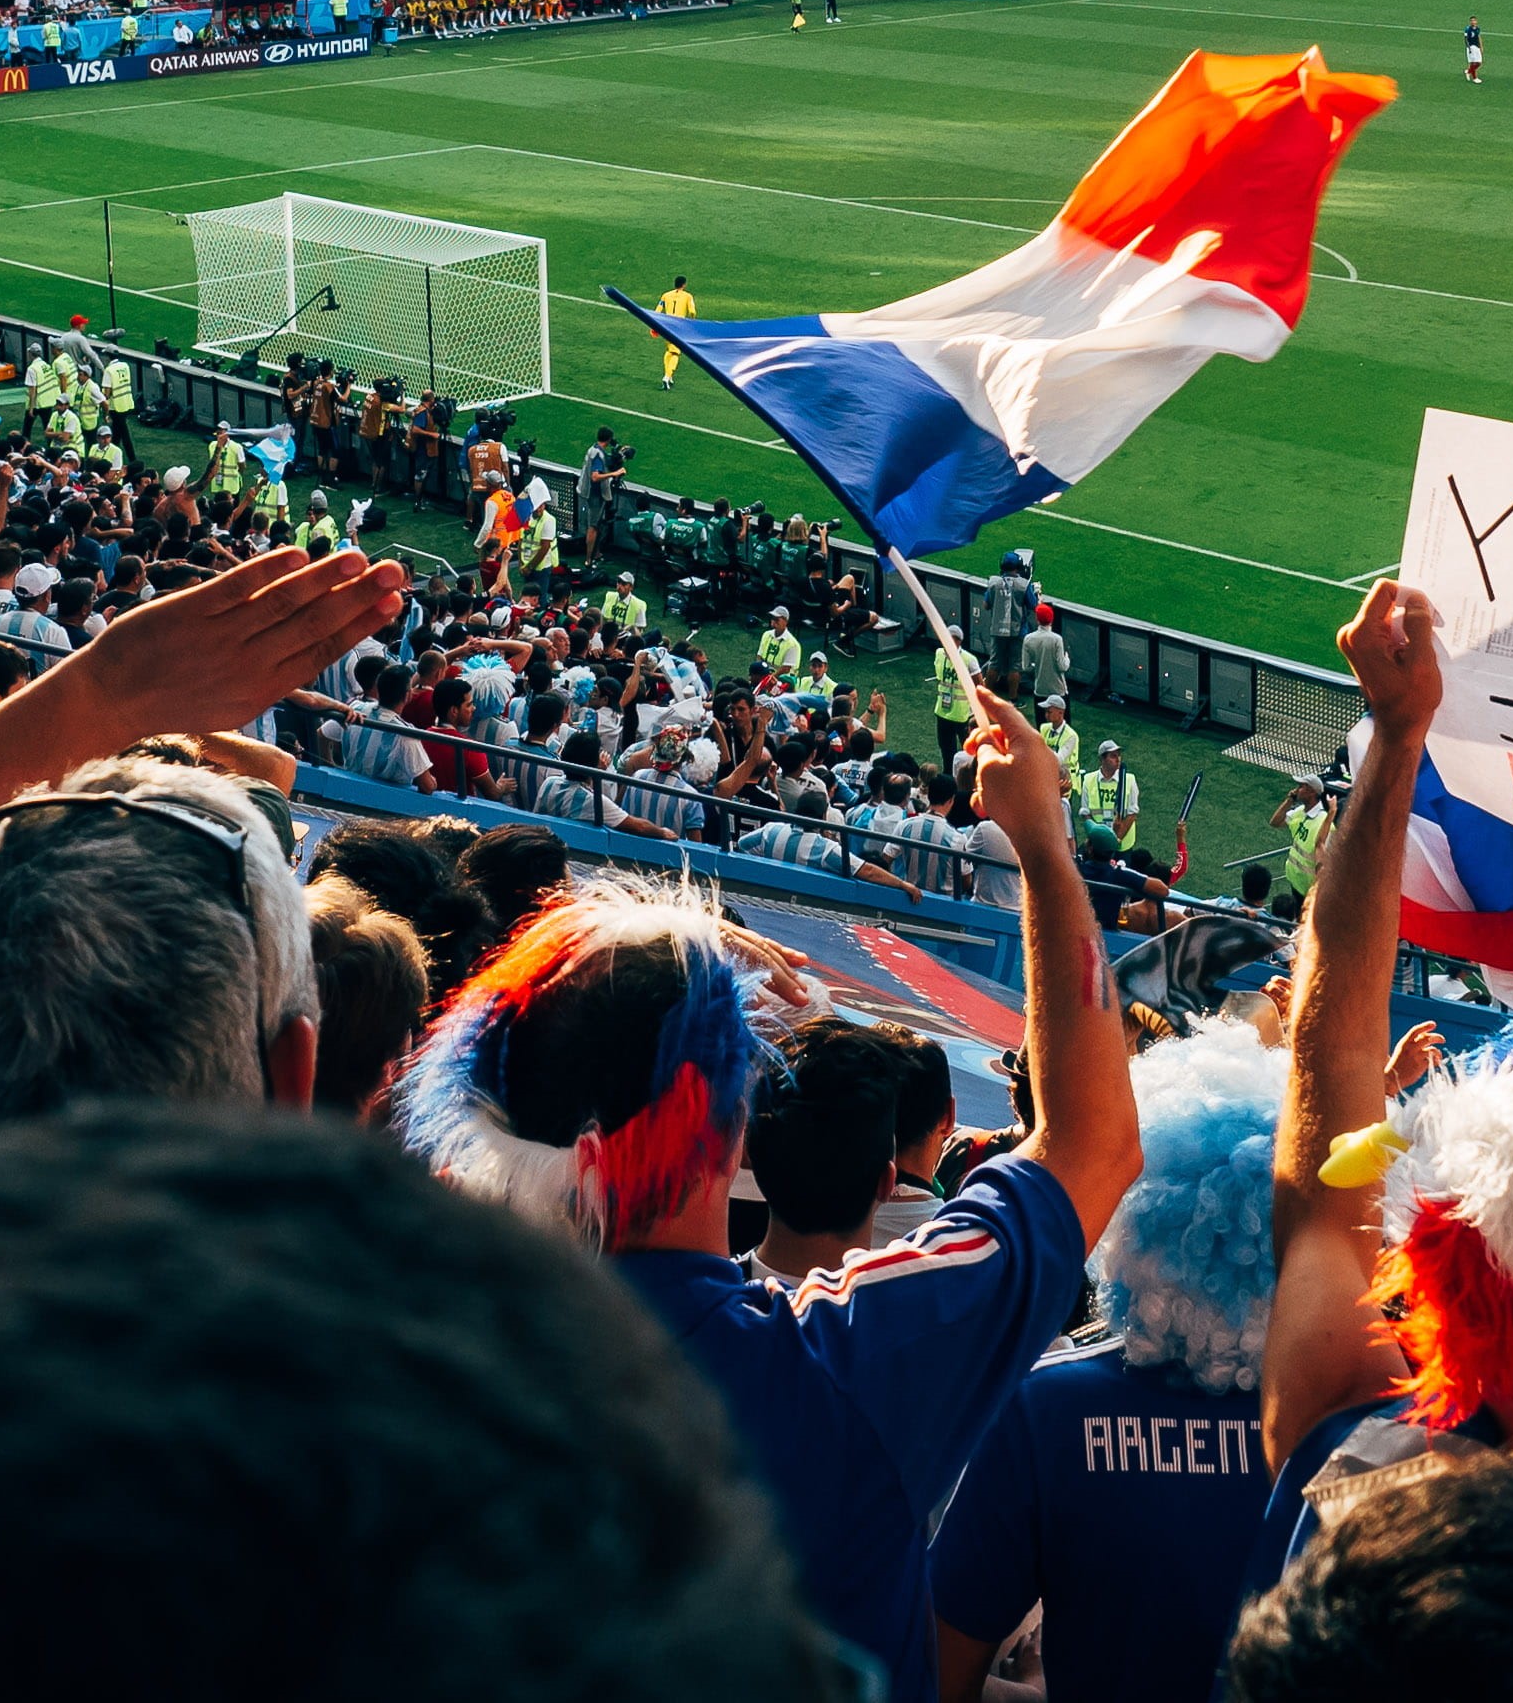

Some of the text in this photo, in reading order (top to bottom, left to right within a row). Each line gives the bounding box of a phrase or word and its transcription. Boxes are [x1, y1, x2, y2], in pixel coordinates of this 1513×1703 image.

[150, 48, 260, 75] QATAR AIRWAYS
[297, 38, 368, 59] HYUNDAI
[62, 59, 116, 85] VISA
